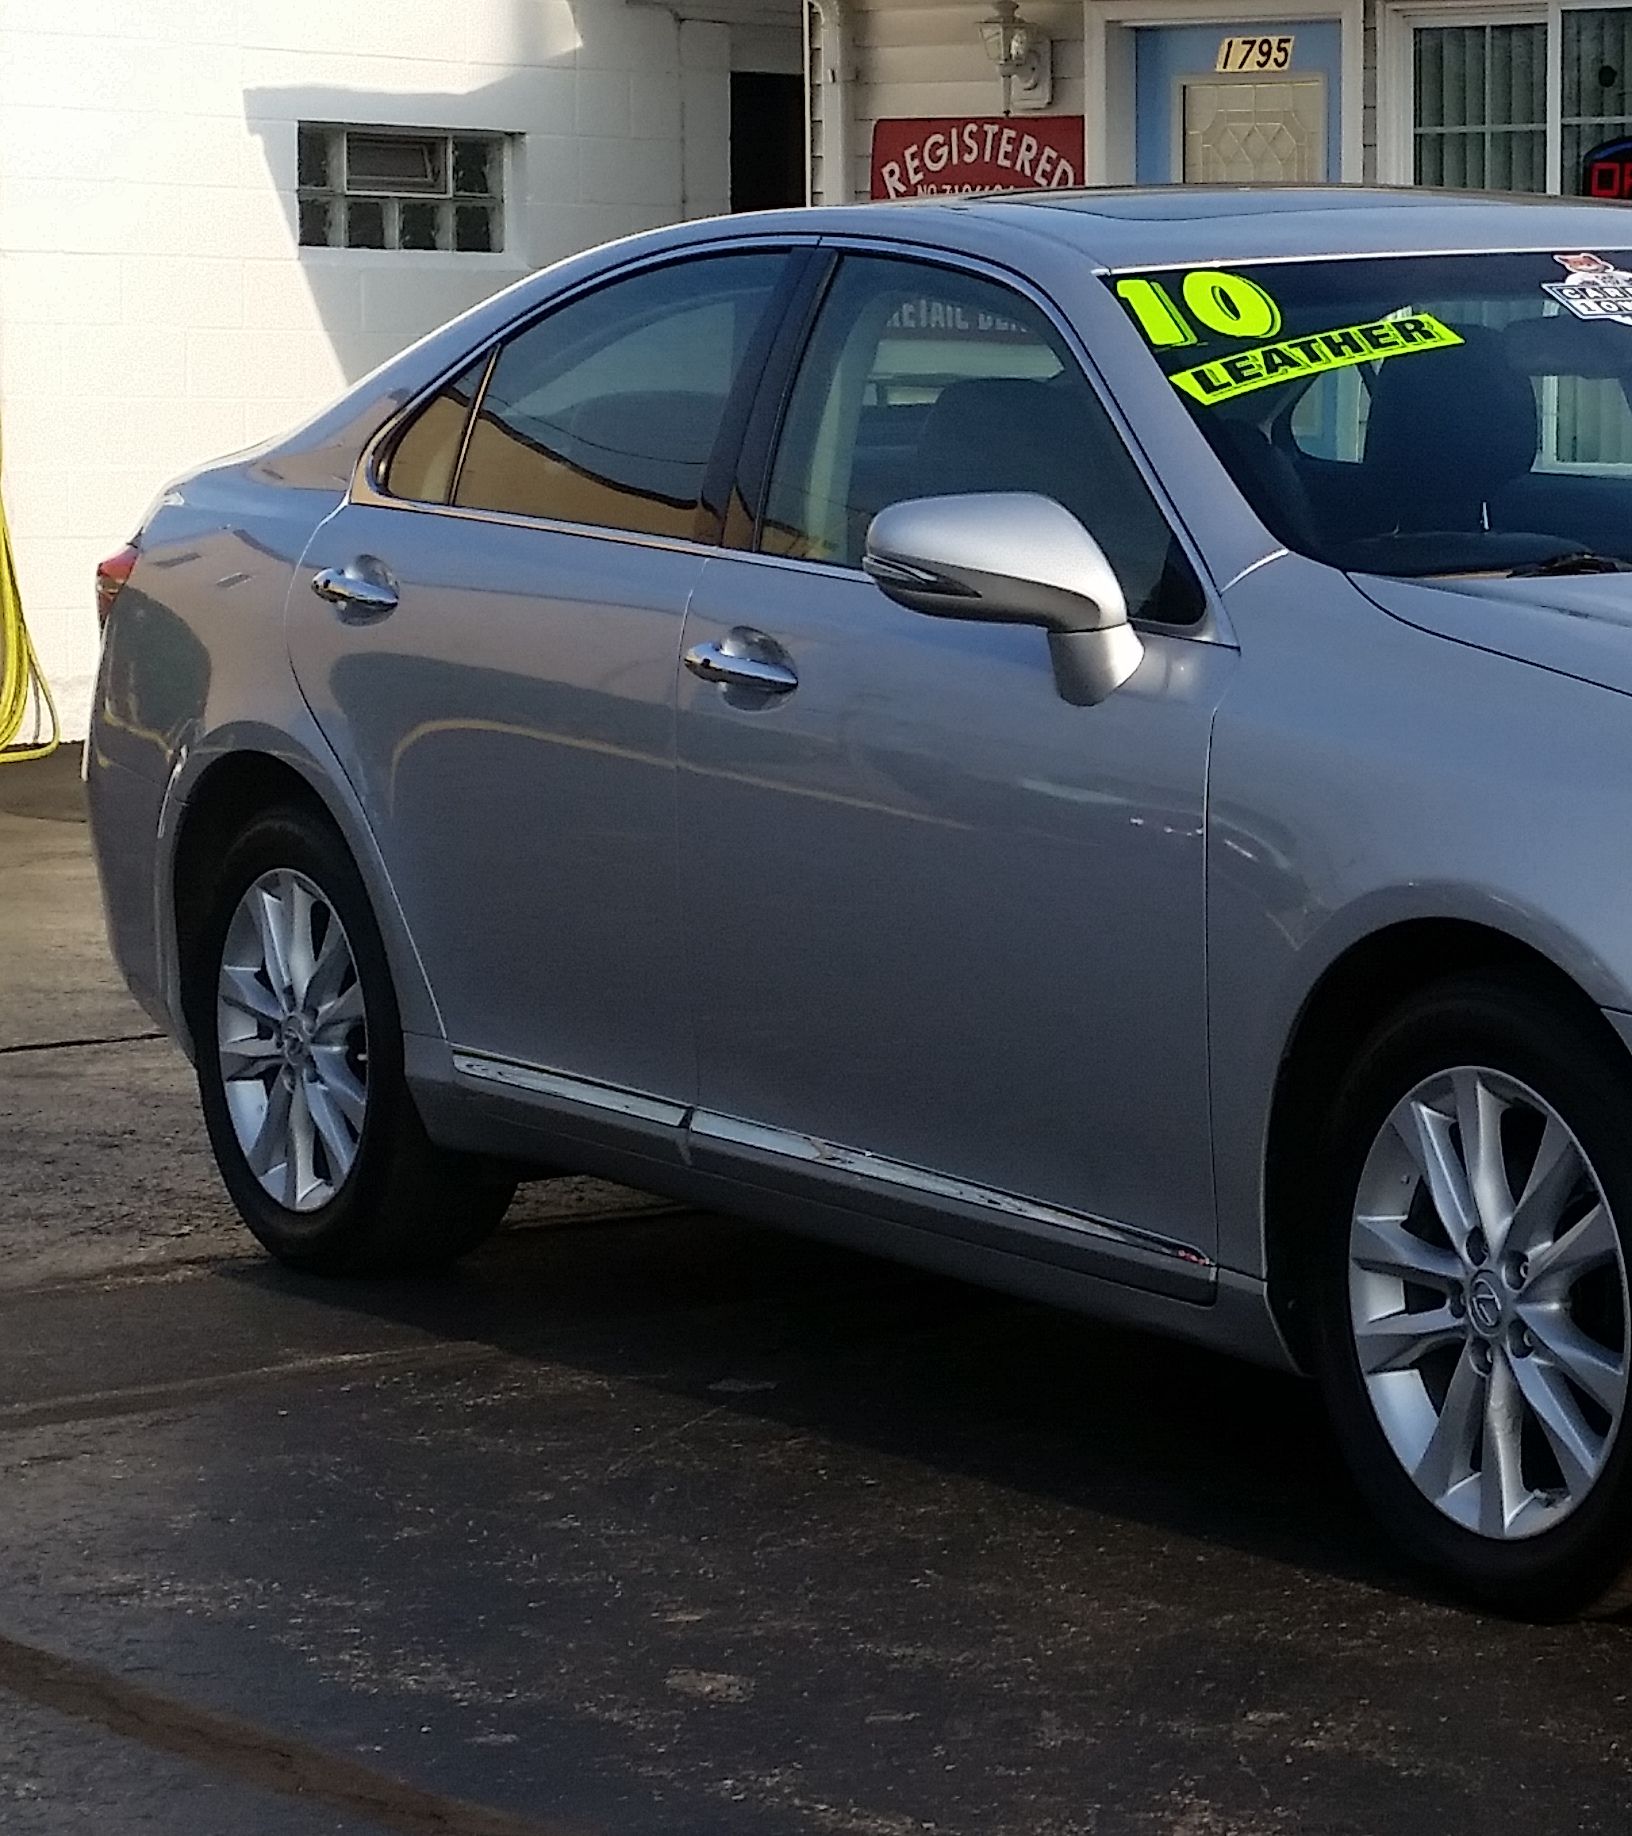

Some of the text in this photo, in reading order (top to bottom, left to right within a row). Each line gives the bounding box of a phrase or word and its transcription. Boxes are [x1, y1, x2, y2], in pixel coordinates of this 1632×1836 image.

[1222, 38, 1291, 70] 1795
[881, 122, 1075, 199] REGISTERED
[1115, 270, 1282, 347] 10
[1190, 317, 1439, 395] LEATHER
